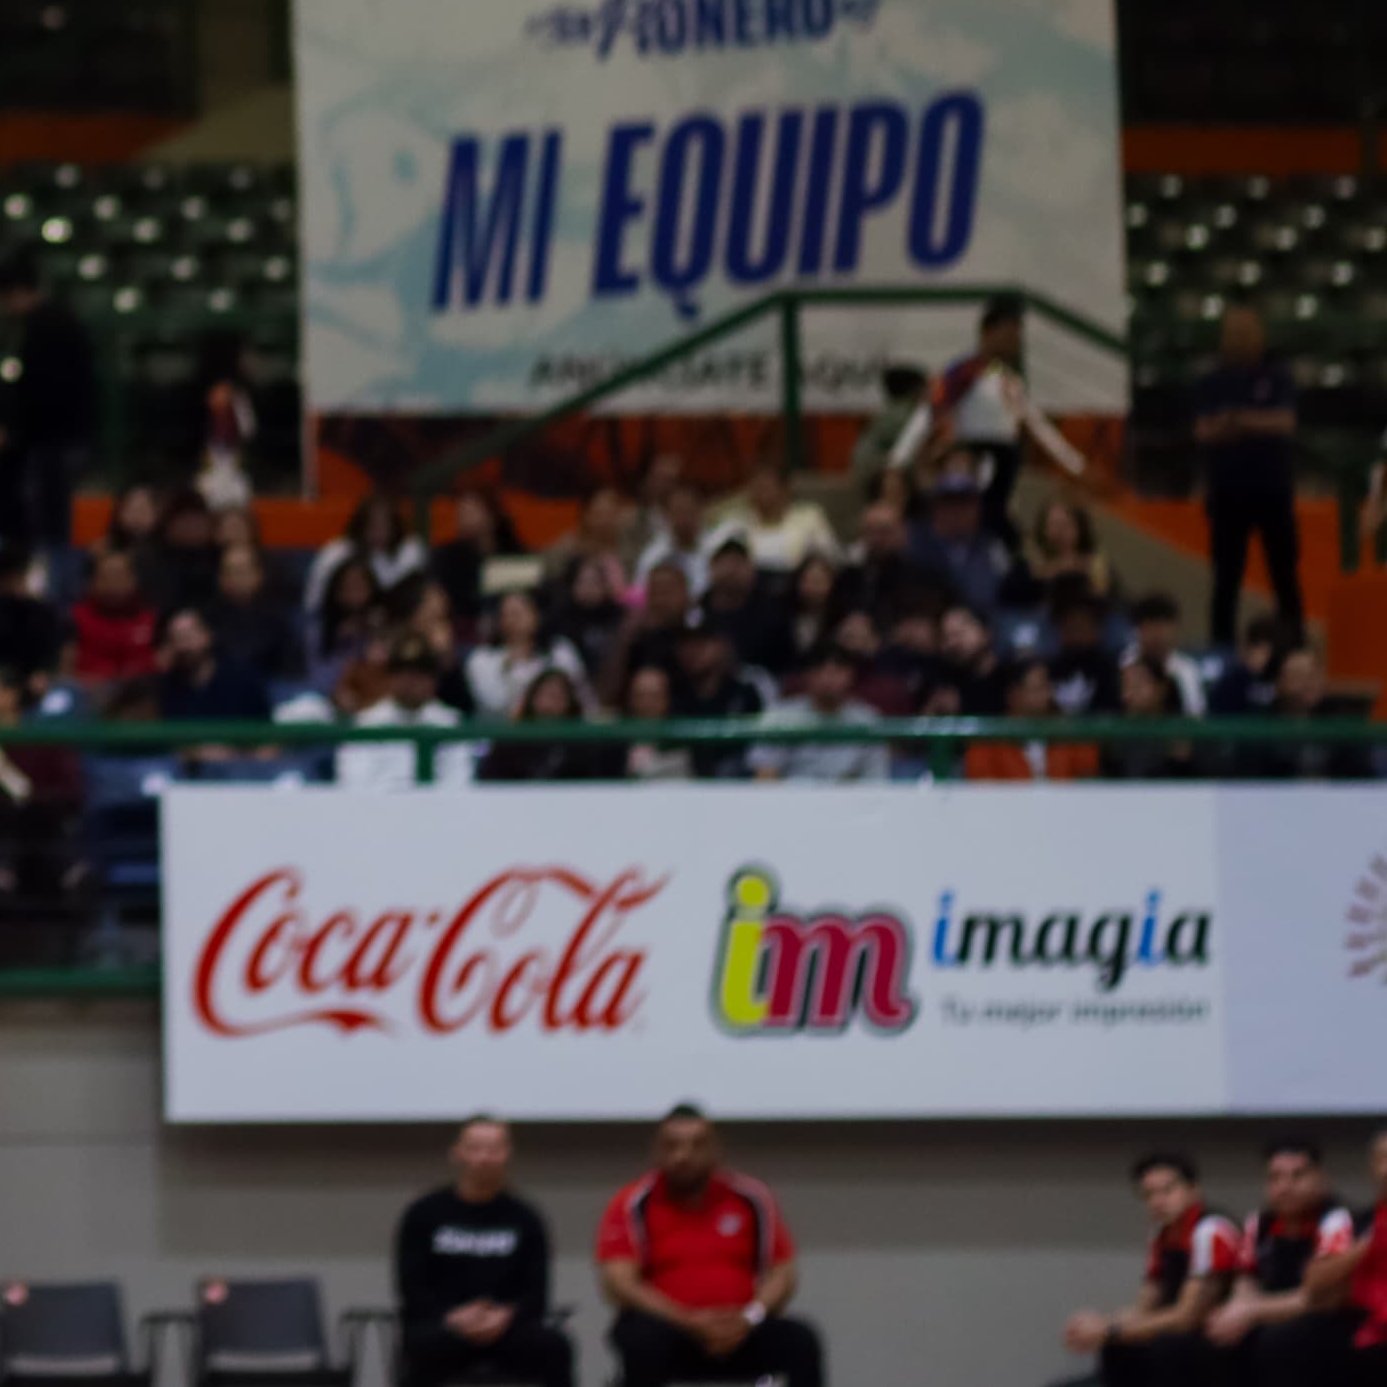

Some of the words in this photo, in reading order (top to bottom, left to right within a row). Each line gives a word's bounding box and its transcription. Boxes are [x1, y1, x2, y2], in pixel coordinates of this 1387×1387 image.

[432, 128, 562, 315] MI
[592, 90, 985, 321] EQUIPO
[191, 862, 676, 1038] Coca-Cola
[931, 889, 1215, 993] imagia
